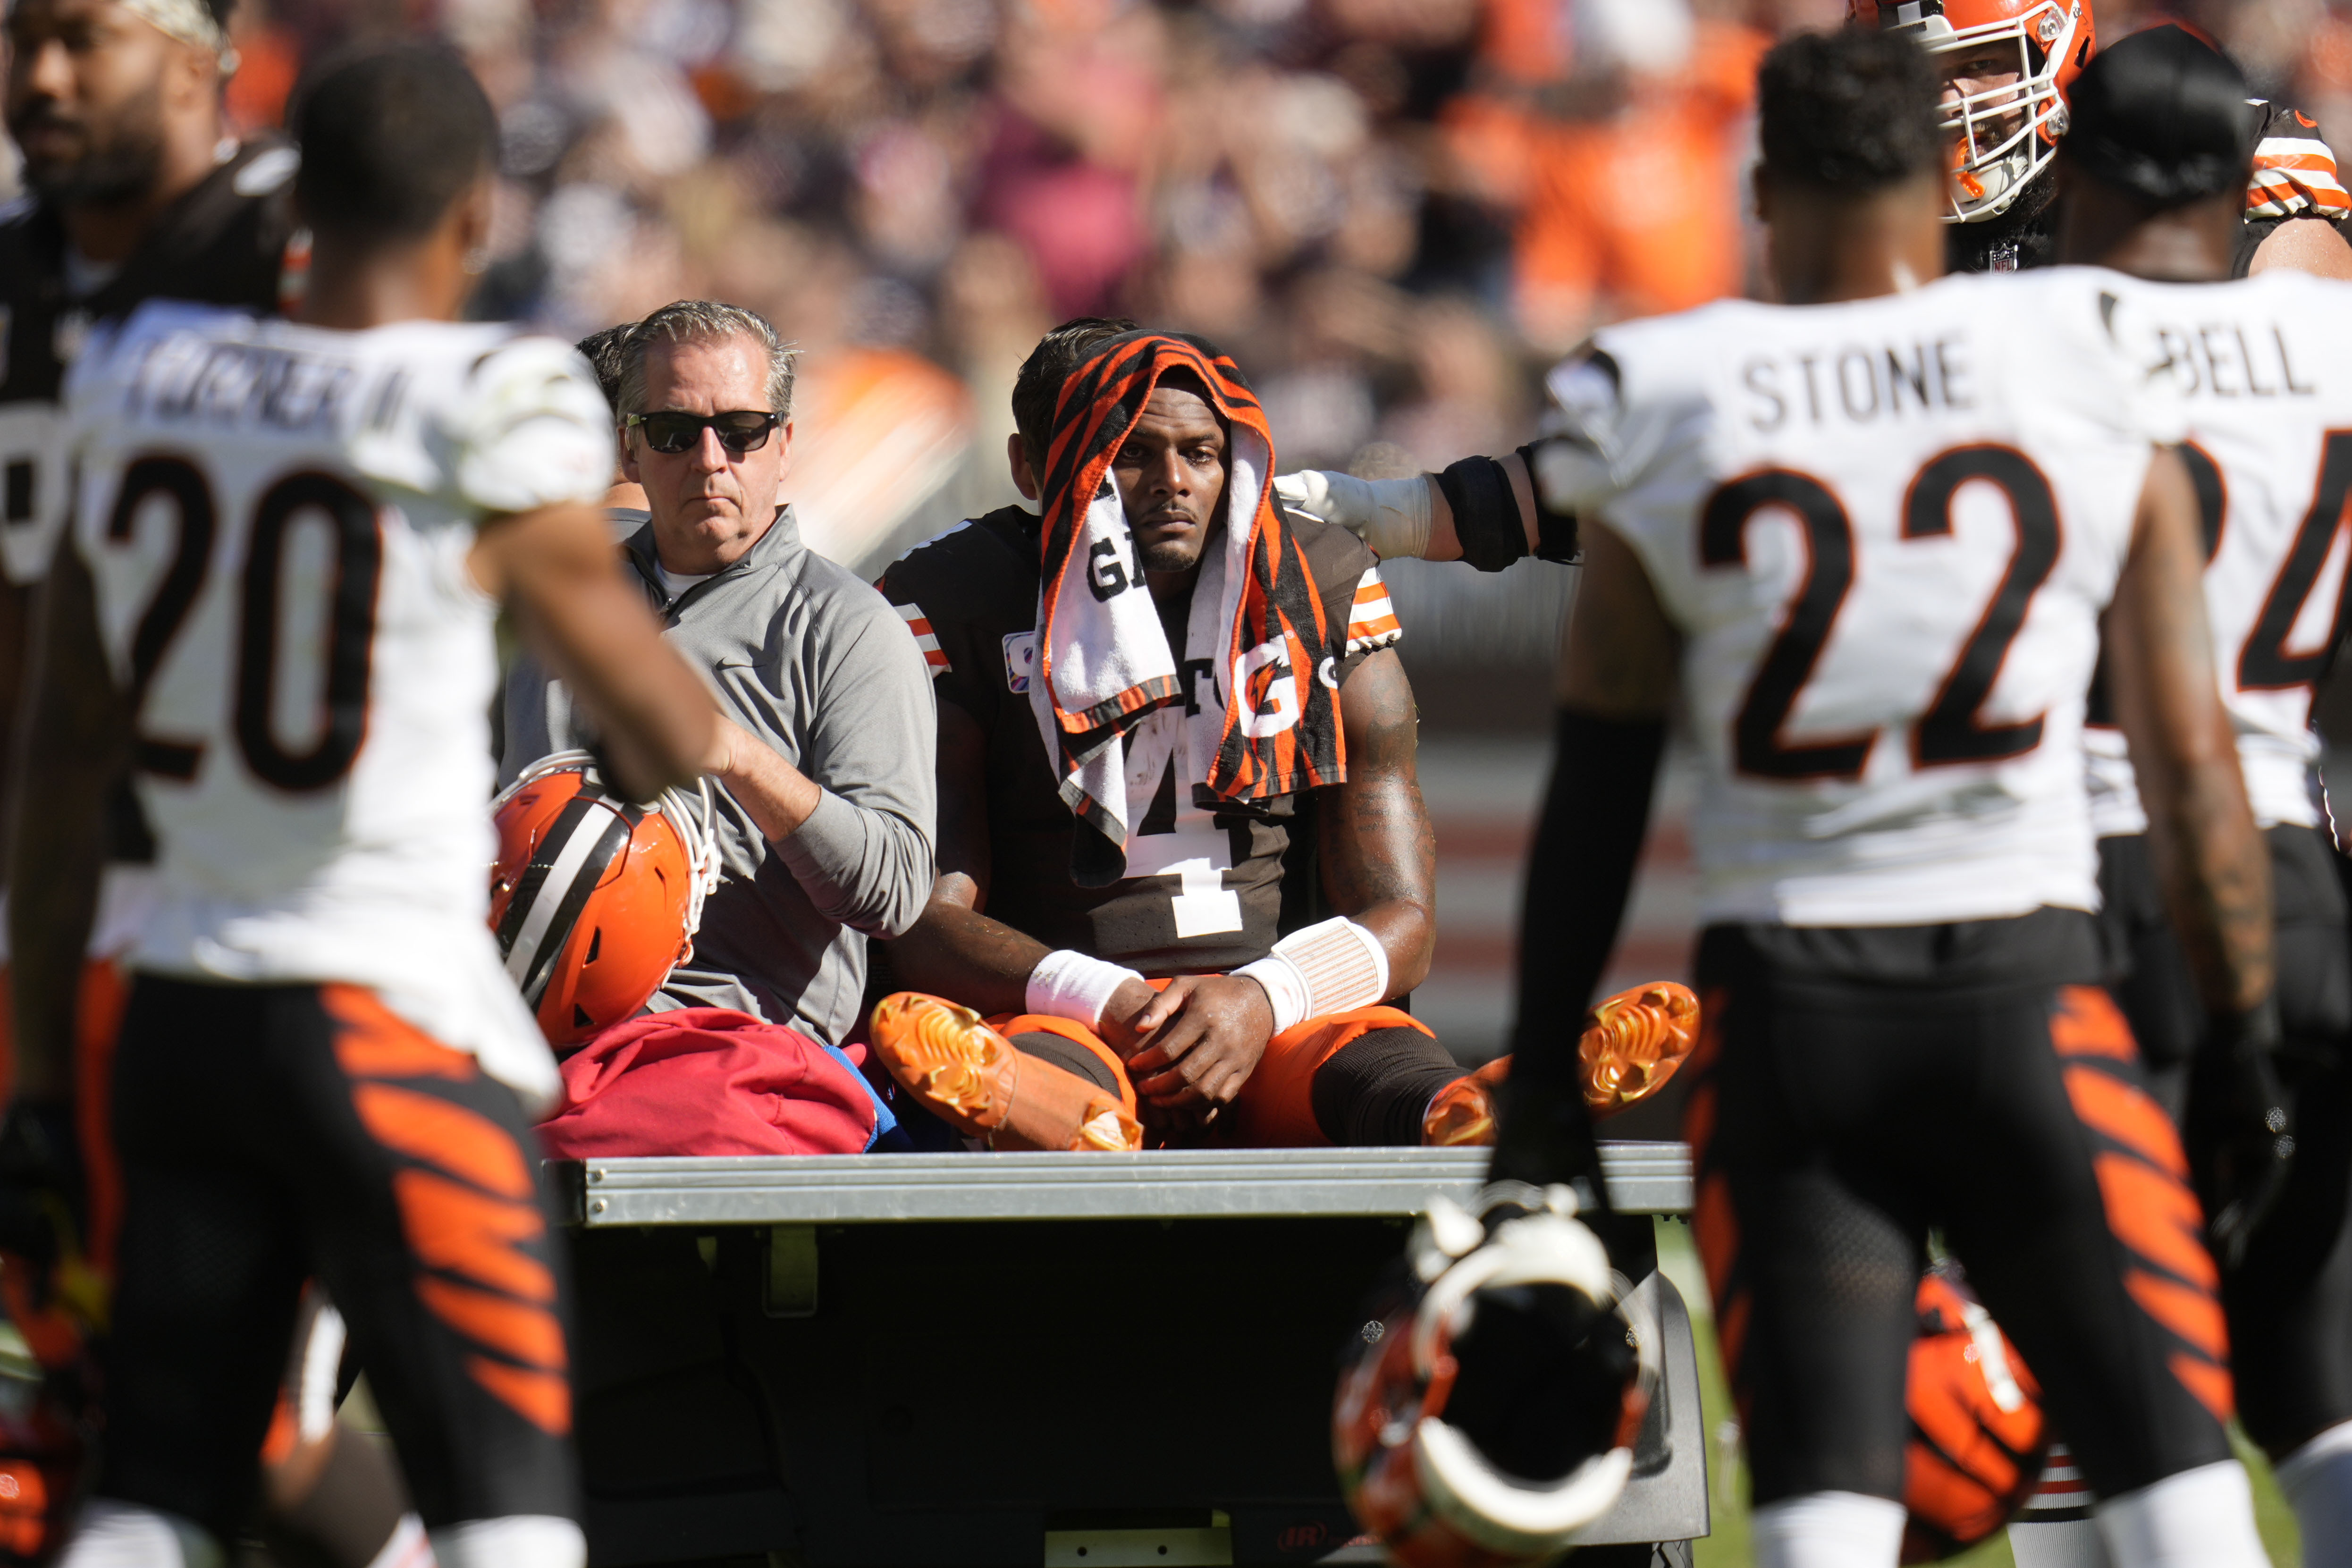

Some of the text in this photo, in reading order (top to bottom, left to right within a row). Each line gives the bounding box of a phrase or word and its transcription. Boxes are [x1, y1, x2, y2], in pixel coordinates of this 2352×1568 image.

[1994, 260, 2012, 274] NFL
[1741, 328, 1976, 430] STONE
[106, 454, 383, 794] 20
[1697, 440, 2063, 783] 22
